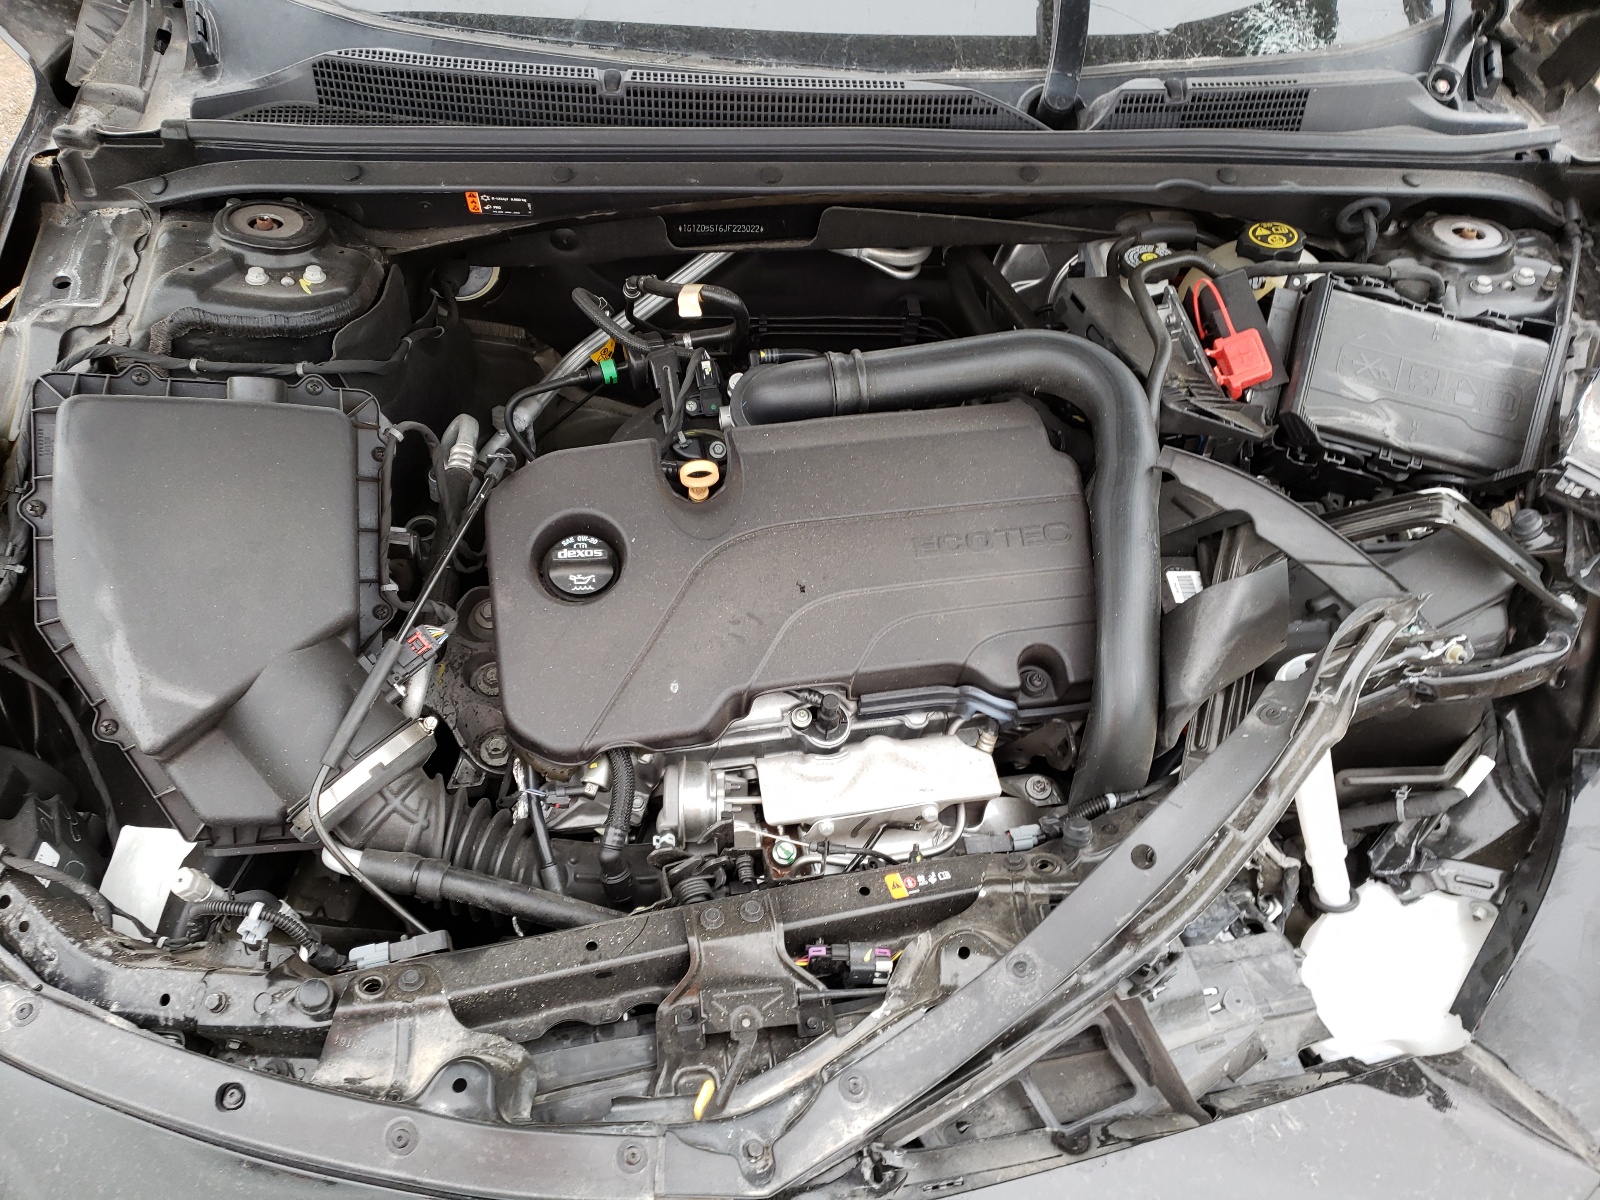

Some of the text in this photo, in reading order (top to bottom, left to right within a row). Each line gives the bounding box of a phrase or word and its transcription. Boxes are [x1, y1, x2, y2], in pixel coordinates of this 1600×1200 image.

[562, 535, 599, 546] SAE 0W-20
[911, 522, 1072, 558] ECOTEC
[557, 548, 604, 559] dexos
